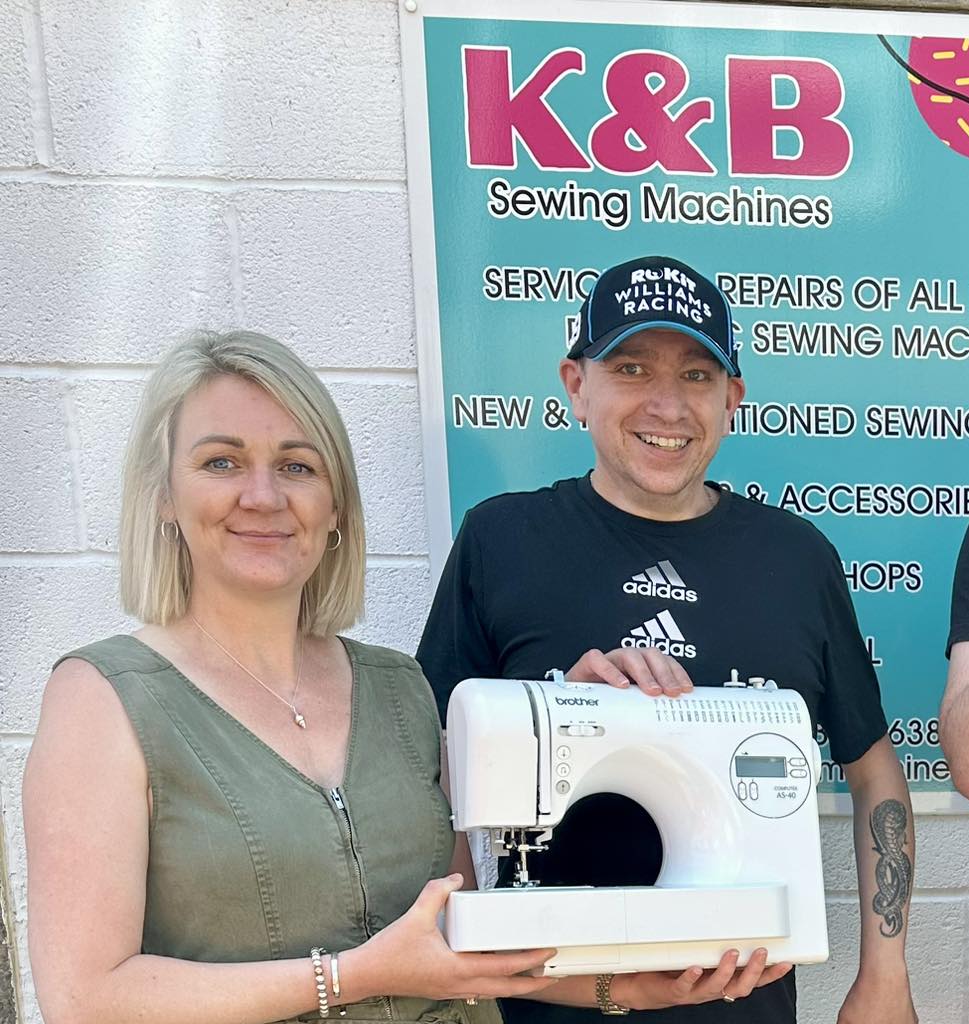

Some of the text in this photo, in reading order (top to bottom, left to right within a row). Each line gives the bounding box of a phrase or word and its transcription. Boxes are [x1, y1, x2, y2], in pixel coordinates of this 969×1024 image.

[461, 44, 854, 181] K&B
[488, 178, 832, 229] Sewing Machines
[483, 265, 603, 301] SERVIC
[716, 273, 842, 309] REPAIRS
[853, 276, 899, 311] OF
[909, 279, 964, 313] ALL
[615, 282, 712, 318] WILLIAMS
[624, 297, 703, 324] RACING
[752, 321, 883, 356] SEWING
[453, 395, 533, 429] NEW
[543, 397, 571, 430] &
[622, 580, 698, 602] adidas
[620, 635, 697, 659] adidas
[555, 696, 600, 707] brother
[776, 791, 797, 799] AS-40
